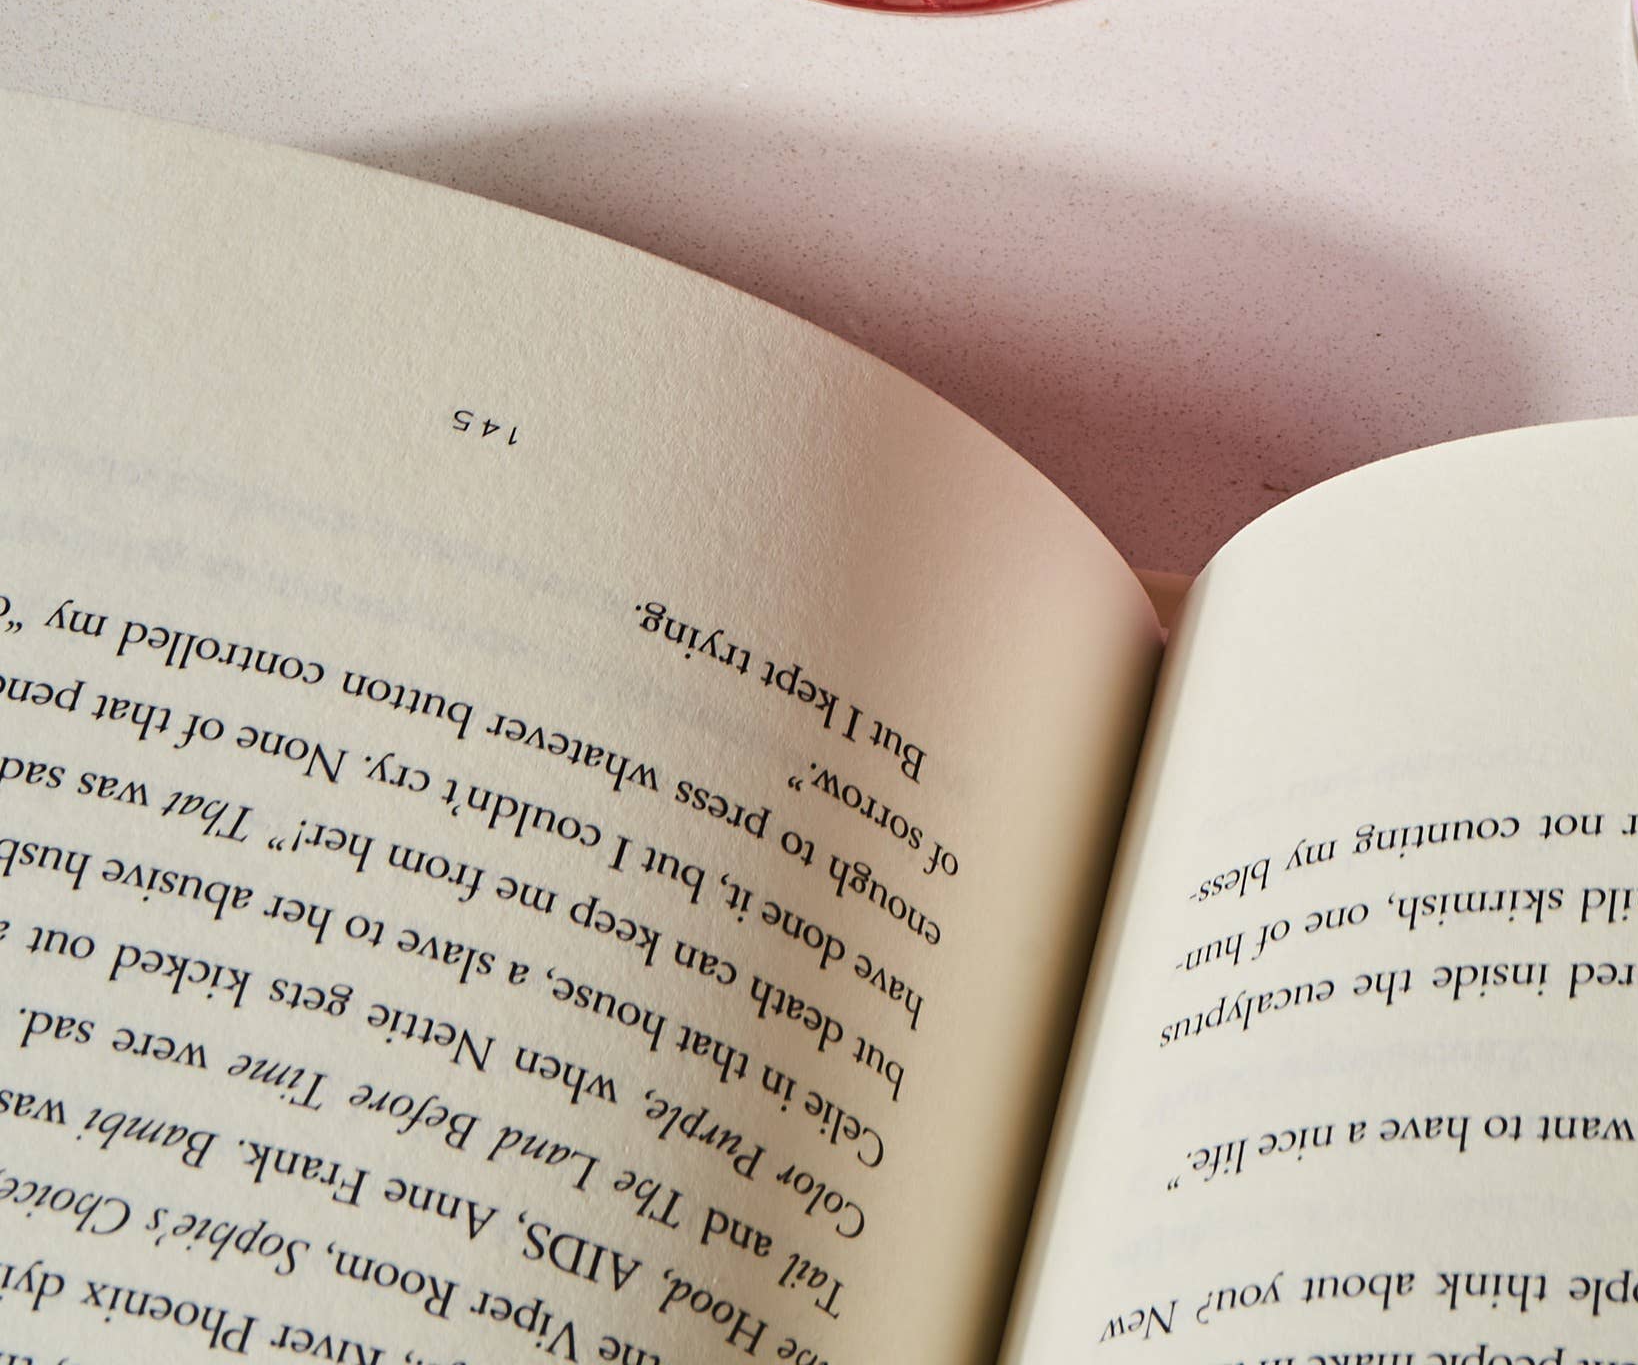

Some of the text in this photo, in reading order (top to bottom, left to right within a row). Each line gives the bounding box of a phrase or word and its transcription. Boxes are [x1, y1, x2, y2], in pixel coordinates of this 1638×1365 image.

[43, 599, 109, 638] my
[116, 620, 325, 685] controlled
[90, 694, 172, 742] that
[342, 670, 474, 741] button
[634, 601, 928, 785] But kept trying.
[172, 713, 225, 750] of
[236, 725, 349, 784] None
[485, 713, 659, 793] whatever
[76, 772, 149, 807] was
[364, 752, 431, 793] cry.
[161, 791, 254, 843] That
[674, 780, 773, 840] press
[1539, 814, 1603, 840] not
[922, 841, 959, 877] of
[1284, 838, 1337, 873] my
[1352, 816, 1520, 859] counting
[388, 843, 486, 903] from
[495, 876, 559, 915] me
[640, 846, 706, 906] but
[720, 872, 754, 924] it,
[1188, 858, 1271, 905] bless-
[828, 854, 941, 946] enough
[1304, 903, 1369, 933] one
[1387, 887, 1564, 932] skirmish,
[569, 895, 663, 968] keep
[761, 901, 846, 971] done
[1174, 932, 1244, 972] hun-
[1251, 919, 1291, 959] of
[674, 940, 738, 986] can
[1353, 968, 1412, 1007] the
[1432, 963, 1548, 1002] inside
[101, 858, 884, 1169] Celie in that house, slave her abusive
[750, 975, 844, 1053] death
[853, 954, 924, 1032] have
[1159, 979, 1335, 1050] eucalyptus
[26, 926, 865, 1239] Color Purple, when Nettie gets kicked out
[852, 1036, 905, 1103] but
[76, 1108, 219, 1169] Bambi
[1258, 1124, 1333, 1161] nice
[1379, 1116, 1469, 1154] have
[1537, 1116, 1636, 1142] want
[19, 1007, 844, 1320] Tail and The Land Before Time were sad.
[238, 1139, 370, 1207] Frank.
[383, 1178, 499, 1241] Anne
[518, 1210, 643, 1292] AIDS,
[326, 1241, 460, 1320] Room,
[1196, 1271, 1285, 1323] you?
[1303, 1272, 1416, 1312] about
[1437, 1272, 1547, 1314] think
[81, 1281, 257, 1355] Phoenix
[469, 1291, 578, 1364] Viper
[658, 1268, 769, 1357] Hood,
[1100, 1300, 1177, 1344] New
